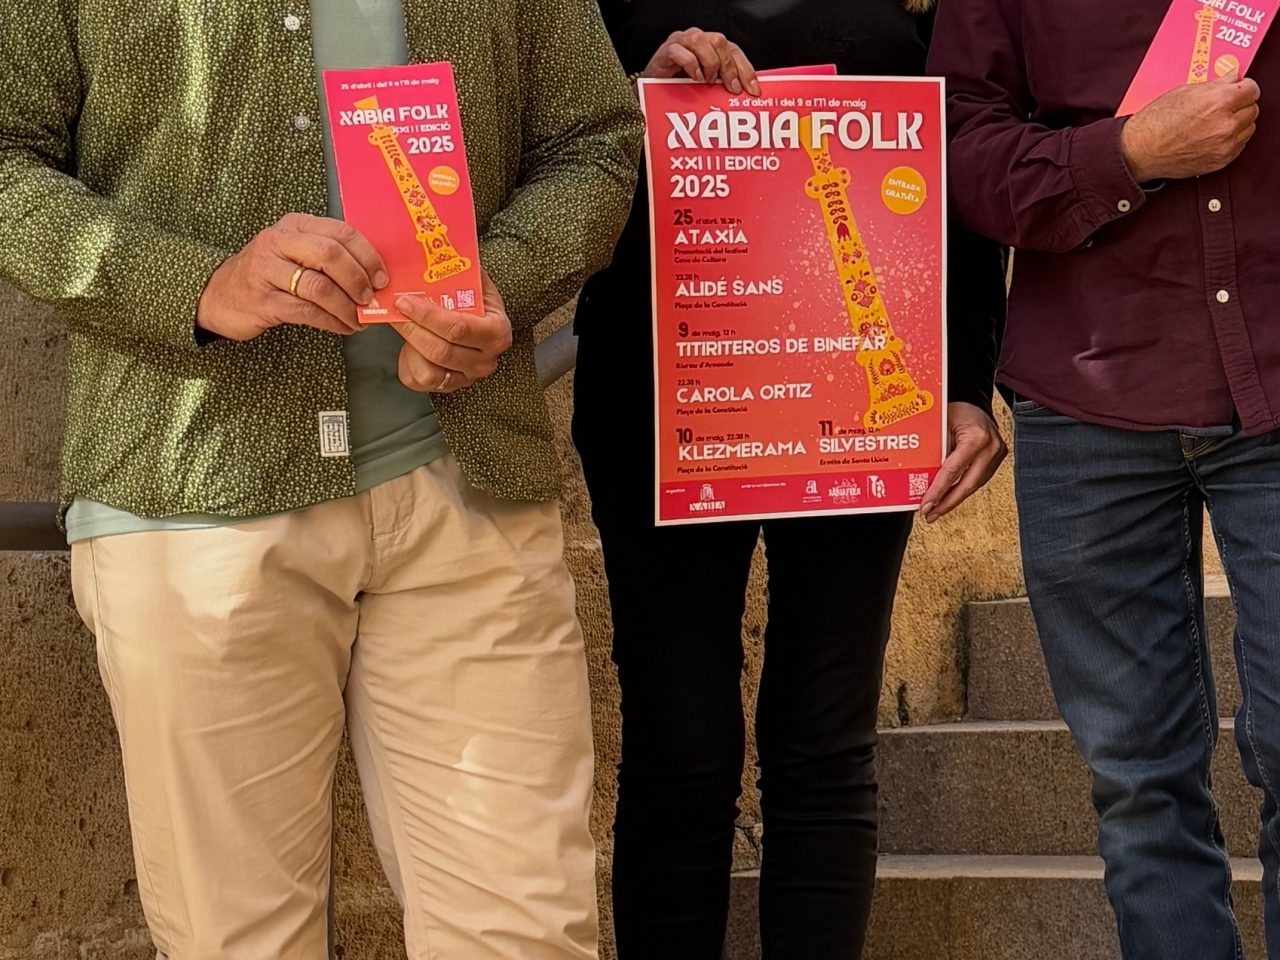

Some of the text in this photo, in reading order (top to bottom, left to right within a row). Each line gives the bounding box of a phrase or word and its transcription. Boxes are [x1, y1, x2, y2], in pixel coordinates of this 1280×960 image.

[1226, 1, 1265, 24] FOLK
[1216, 26, 1252, 48] 2025
[399, 104, 449, 122] FOLK
[729, 99, 740, 107] 25
[742, 98, 773, 107] d'abril
[780, 98, 795, 107] del
[798, 98, 803, 107] 9
[828, 99, 840, 107] de
[843, 99, 867, 110] maig
[665, 106, 923, 150] XÀBIA FOLK
[407, 136, 454, 154] 2025
[725, 152, 780, 171] EDICIÓ
[670, 175, 730, 198] 2025
[888, 178, 921, 192] ENTRADA
[673, 209, 693, 225] 25
[674, 224, 748, 245] ATAXÍA
[675, 276, 783, 297] ALIDÉ SANS
[679, 322, 689, 338] 9
[676, 332, 886, 357] TITIRITEROS DE BINÉFAR
[676, 383, 812, 403] CAROLA ORTIZ
[676, 428, 693, 444] 10
[819, 421, 833, 436] 11
[679, 440, 807, 461] KLEZMERAMA
[820, 434, 920, 453] SILVESTRES
